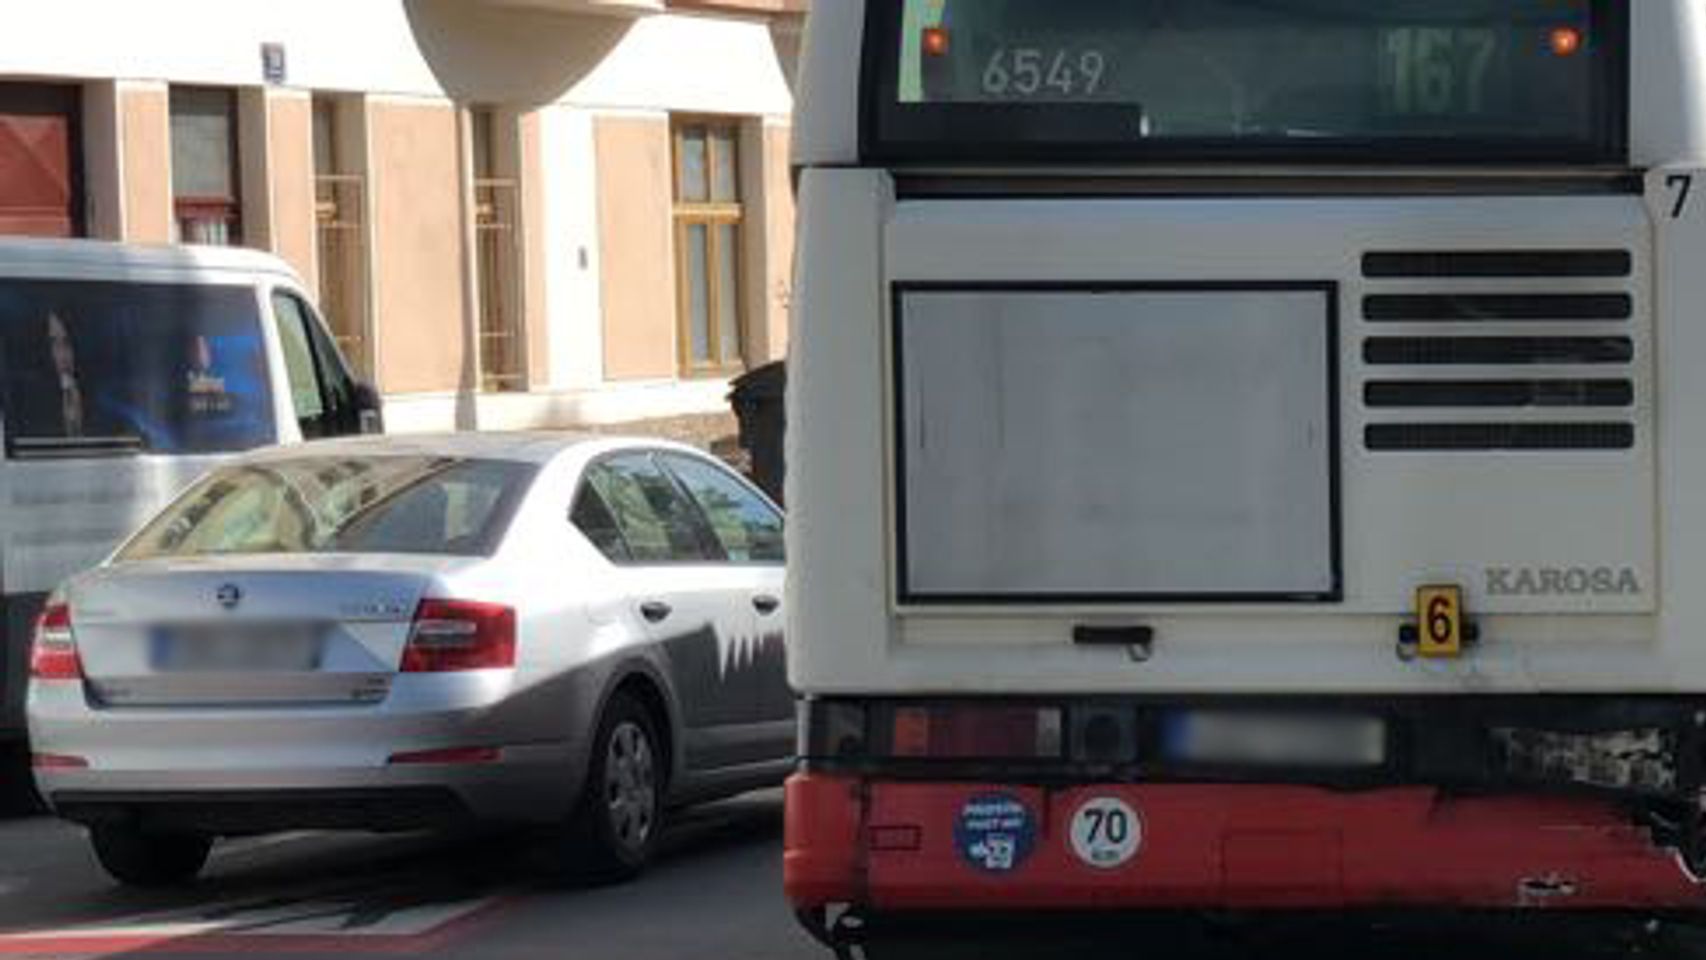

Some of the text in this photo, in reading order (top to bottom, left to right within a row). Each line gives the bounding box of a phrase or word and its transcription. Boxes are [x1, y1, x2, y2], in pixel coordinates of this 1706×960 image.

[982, 50, 1105, 94] 6549
[1388, 28, 1495, 112] 167
[1666, 174, 1691, 218] 7
[1486, 567, 1642, 595] KAROSA
[1427, 597, 1452, 643] 6
[1084, 809, 1128, 843] 70
